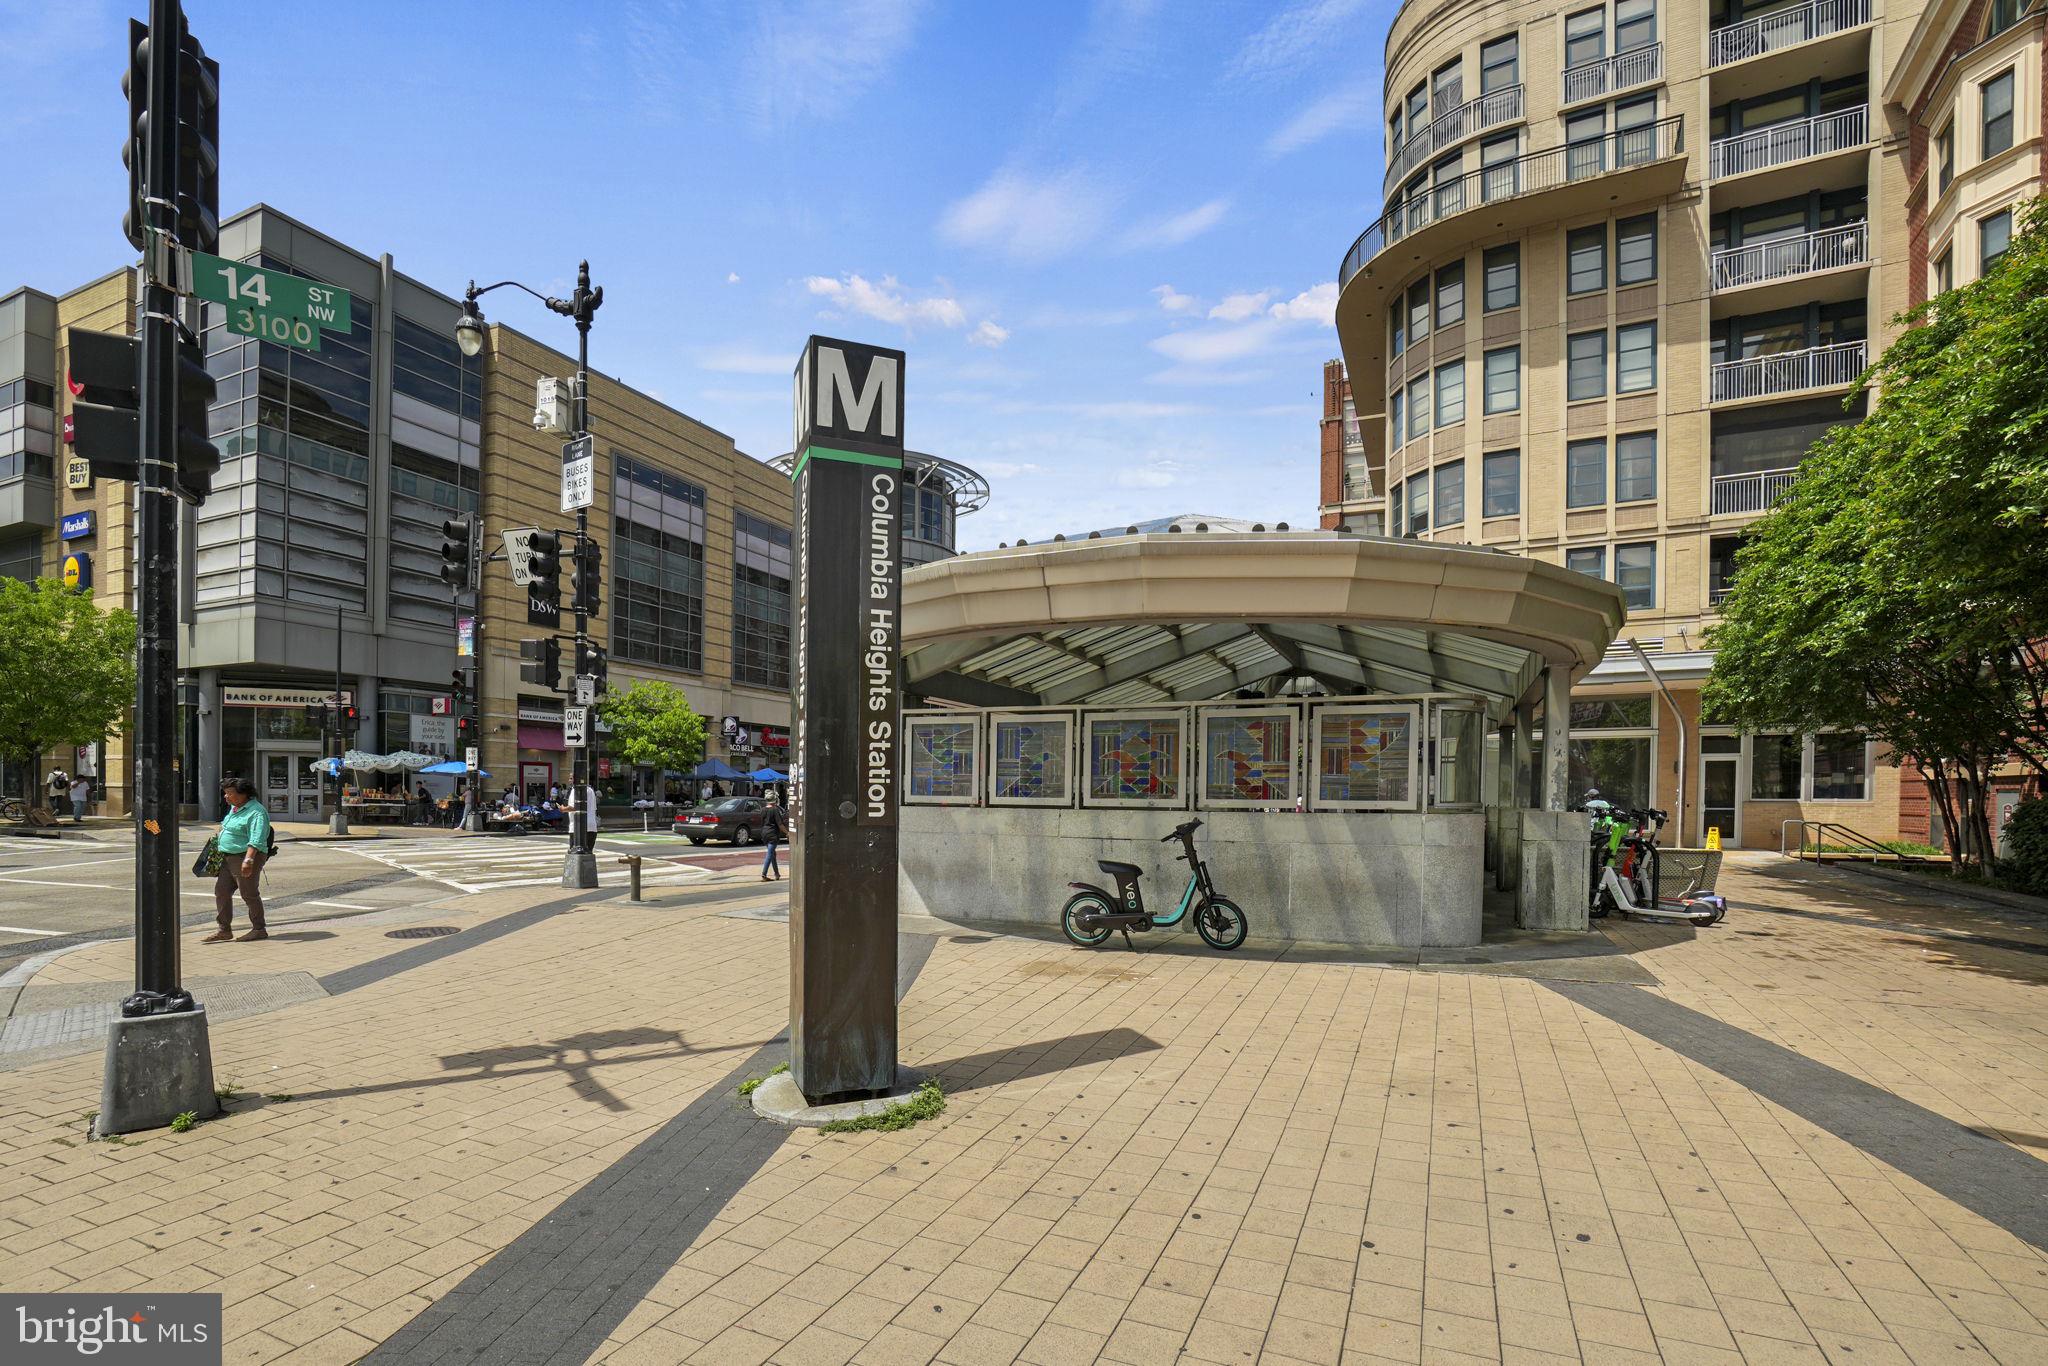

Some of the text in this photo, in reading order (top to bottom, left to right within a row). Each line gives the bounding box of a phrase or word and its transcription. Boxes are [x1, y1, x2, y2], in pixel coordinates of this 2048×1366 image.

[217, 266, 271, 307] 14
[308, 287, 334, 305] ST
[307, 304, 335, 322] NW
[237, 309, 312, 345] 3100
[816, 345, 897, 438] M
[794, 346, 811, 454] M
[69, 462, 88, 473] BEST
[566, 462, 589, 478] BUSES
[69, 473, 86, 484] BUY
[567, 476, 588, 491] BIKES
[567, 490, 586, 504] ONLY
[62, 517, 89, 534] Marshalls
[800, 469, 808, 598] Columbia
[515, 536, 530, 547] NO
[515, 551, 538, 564] TURN
[515, 568, 528, 579] ON
[864, 473, 895, 818] Columbia Heights Station
[226, 693, 256, 701] BANK
[275, 695, 324, 704] AMERICA
[567, 711, 583, 720] ONE
[567, 721, 583, 731] WAY
[1125, 882, 1136, 909] veo
